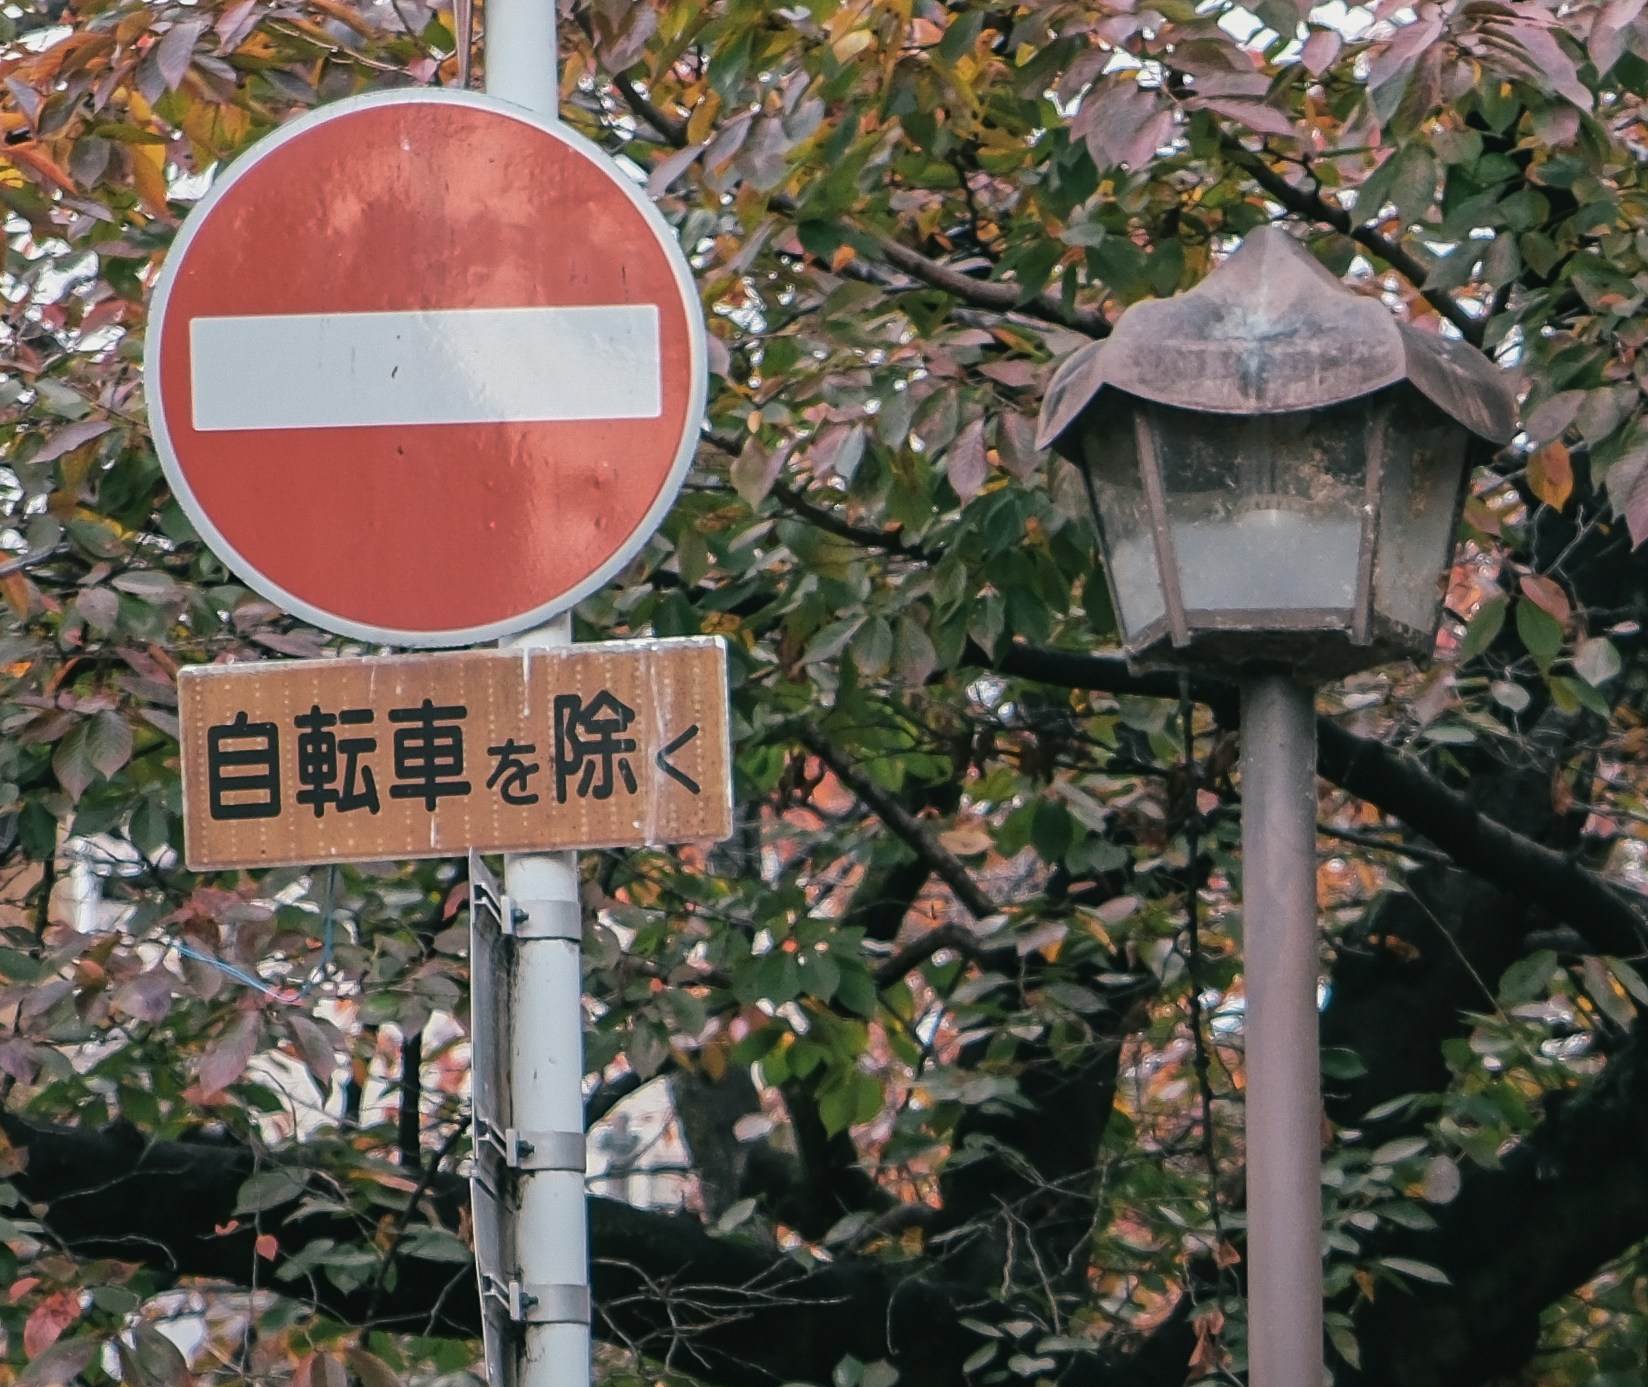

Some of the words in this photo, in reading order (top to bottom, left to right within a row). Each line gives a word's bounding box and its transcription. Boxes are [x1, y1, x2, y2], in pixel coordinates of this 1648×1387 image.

[205, 689, 702, 821] 自転車を除く
